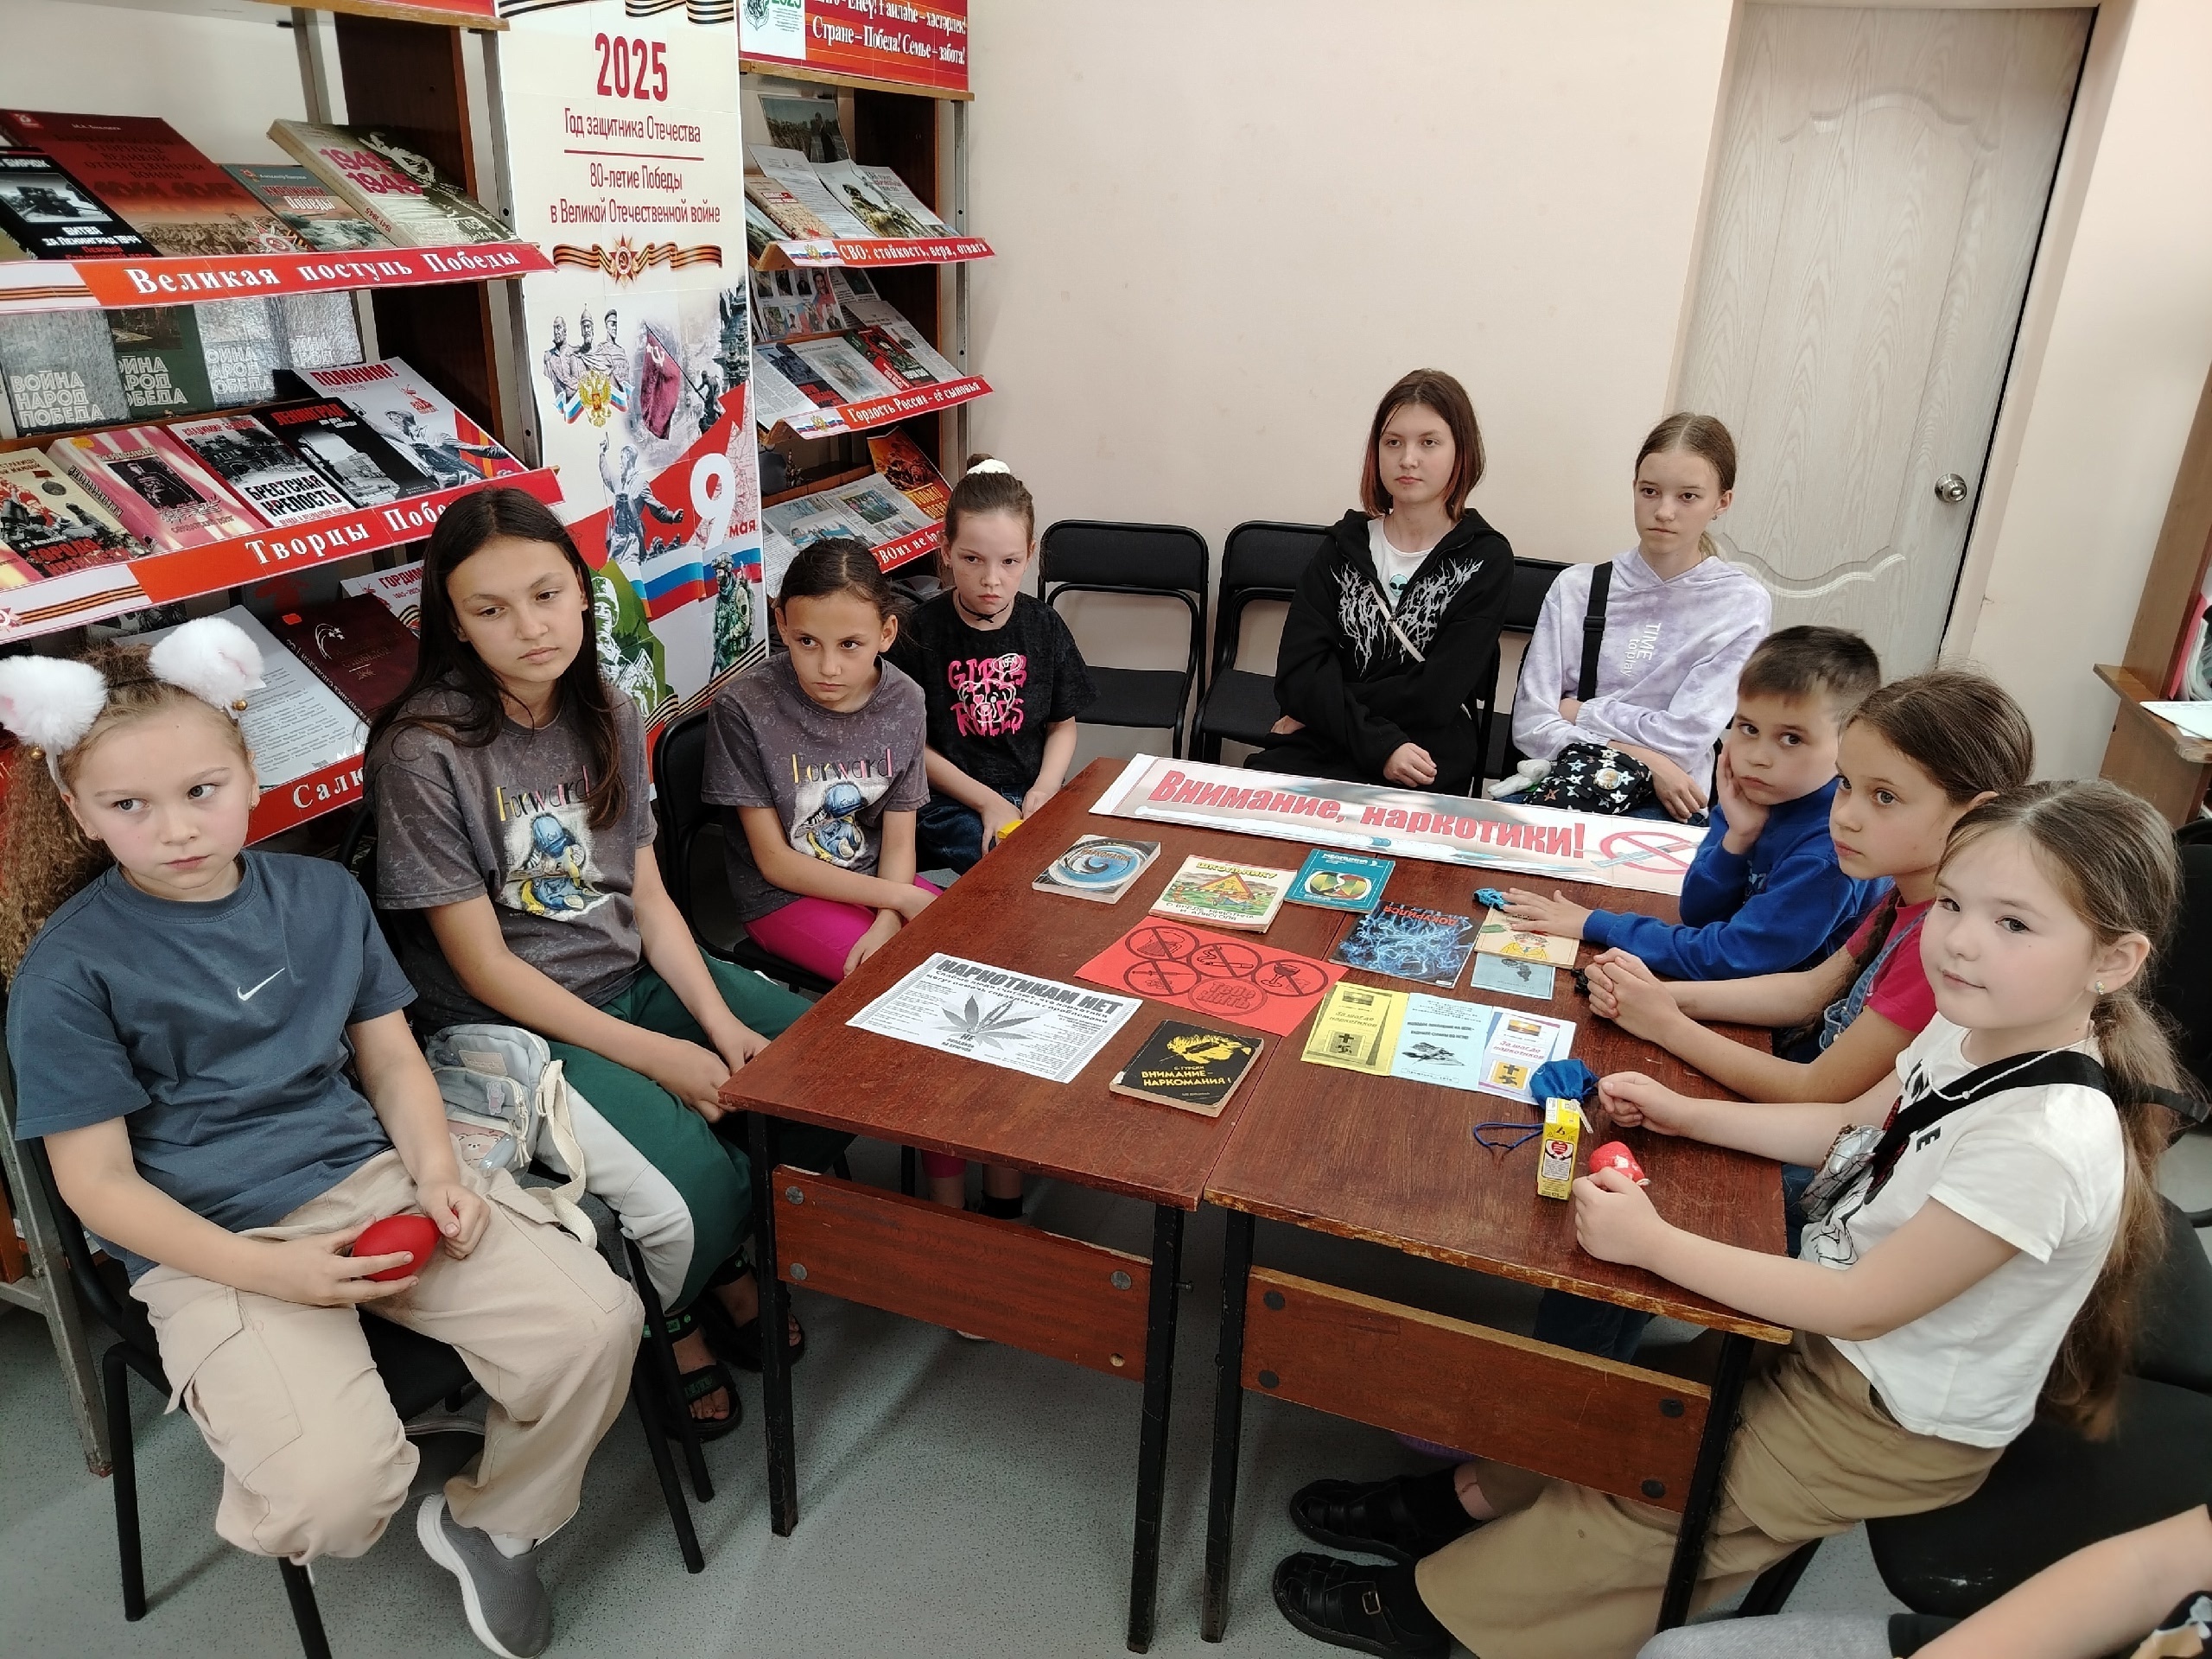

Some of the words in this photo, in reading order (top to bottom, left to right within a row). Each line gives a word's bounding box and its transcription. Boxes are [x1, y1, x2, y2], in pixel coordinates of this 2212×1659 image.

[813, 16, 854, 46] Стране
[864, 25, 901, 54] Победа!
[903, 35, 931, 59] Семье
[939, 45, 966, 65] забота!
[594, 32, 669, 102] 2025
[564, 107, 585, 138] Год
[587, 116, 644, 140] защитника
[647, 115, 702, 143] Отечества
[346, 172, 423, 194] 1945
[590, 162, 639, 188] 80-летие
[642, 165, 683, 193] Победы
[283, 195, 336, 212] Победы
[550, 204, 558, 224] в
[560, 197, 607, 224] Великой
[609, 198, 688, 224] Отечественной
[691, 200, 721, 224] войне
[365, 207, 391, 233] 1941-1945
[838, 245, 869, 261] СВО:
[874, 244, 930, 262] стойкость,
[931, 245, 957, 258] вера,
[957, 242, 988, 256] отвага
[124, 267, 281, 295] Великая
[296, 258, 413, 284] поступь
[422, 249, 522, 274] Победы
[118, 354, 169, 374] ЙНА
[207, 346, 258, 364] ОЙНА
[10, 369, 85, 393] ВОЙНА
[209, 361, 261, 378] АРОД
[309, 362, 400, 387] ПОМНИМ!
[124, 373, 173, 392] РОД
[213, 374, 273, 394] ОБЕДА
[15, 389, 89, 410] НАРОД
[128, 389, 188, 407] БЕДА
[847, 402, 896, 424] Гордость
[893, 394, 929, 414] России
[933, 389, 944, 403] её
[944, 380, 982, 400] сыновья
[21, 404, 105, 429] ПОБЕДА
[270, 404, 349, 426] ЛЕНИНГРАД
[244, 474, 327, 501] БРЕСТСКАЯ
[912, 486, 944, 505] ТОЛЬКО
[260, 489, 343, 518] КРЕПОСТЬ
[690, 453, 736, 550] 9
[246, 522, 372, 566] Творцы
[382, 500, 447, 532] Побе
[729, 519, 756, 538] мая
[912, 537, 928, 550] не
[1628, 639, 1640, 651] to
[1636, 622, 1662, 661] TIME
[299, 652, 332, 684] ПОБЕДОЙ
[1620, 652, 1637, 677] play
[791, 747, 893, 784] Forward
[292, 772, 364, 810] Салю
[496, 765, 590, 822] Forward
[1147, 769, 1345, 823] Внимание,
[1360, 805, 1586, 859] наркотики!
[1196, 861, 1278, 879] ШКОЛЬНИКУ
[1191, 911, 1237, 921] АЛКОГОЛЯ
[1209, 909, 1255, 918] НИКОТИНА
[1383, 904, 1460, 927] ДОКУРИЛСЯ
[926, 973, 951, 984] могут
[954, 979, 986, 992] помочь
[988, 988, 1039, 1007] справиться
[1047, 1005, 1109, 1024] проблемами
[936, 969, 969, 983] Слабые
[974, 979, 995, 989] люди
[996, 986, 1038, 1001] считают,
[1057, 1001, 1108, 1019] наркотики
[937, 959, 1081, 1004] НАРКОТИКАМ
[1079, 995, 1123, 1015] НЕТ
[1329, 1017, 1378, 1028] наркотиков
[960, 1033, 976, 1042] НЕ
[1493, 1045, 1545, 1059] наркотиков
[1141, 1070, 1206, 1078] ВНИМАНИЕ
